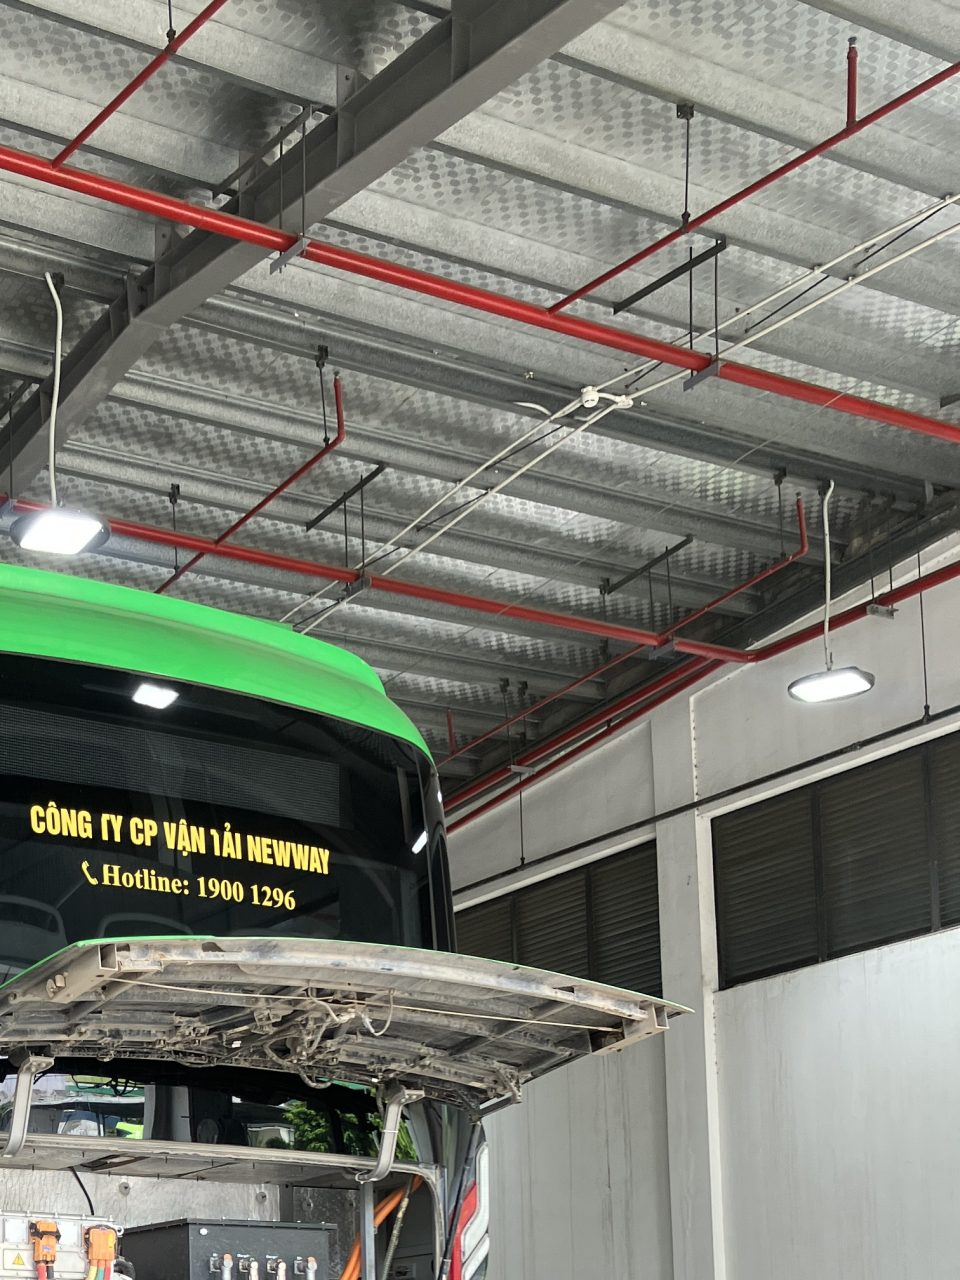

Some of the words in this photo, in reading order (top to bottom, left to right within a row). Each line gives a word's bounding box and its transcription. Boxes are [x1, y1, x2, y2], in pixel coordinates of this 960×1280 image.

[30, 801, 93, 839] CÔNG
[101, 813, 123, 843] TY
[130, 816, 158, 847] CP
[163, 818, 206, 857] VẬN
[210, 822, 242, 860] TẢI
[246, 834, 330, 875] NEWWAY
[102, 863, 189, 896] Hotline:
[196, 876, 244, 903] 1900
[249, 884, 296, 911] 1296
